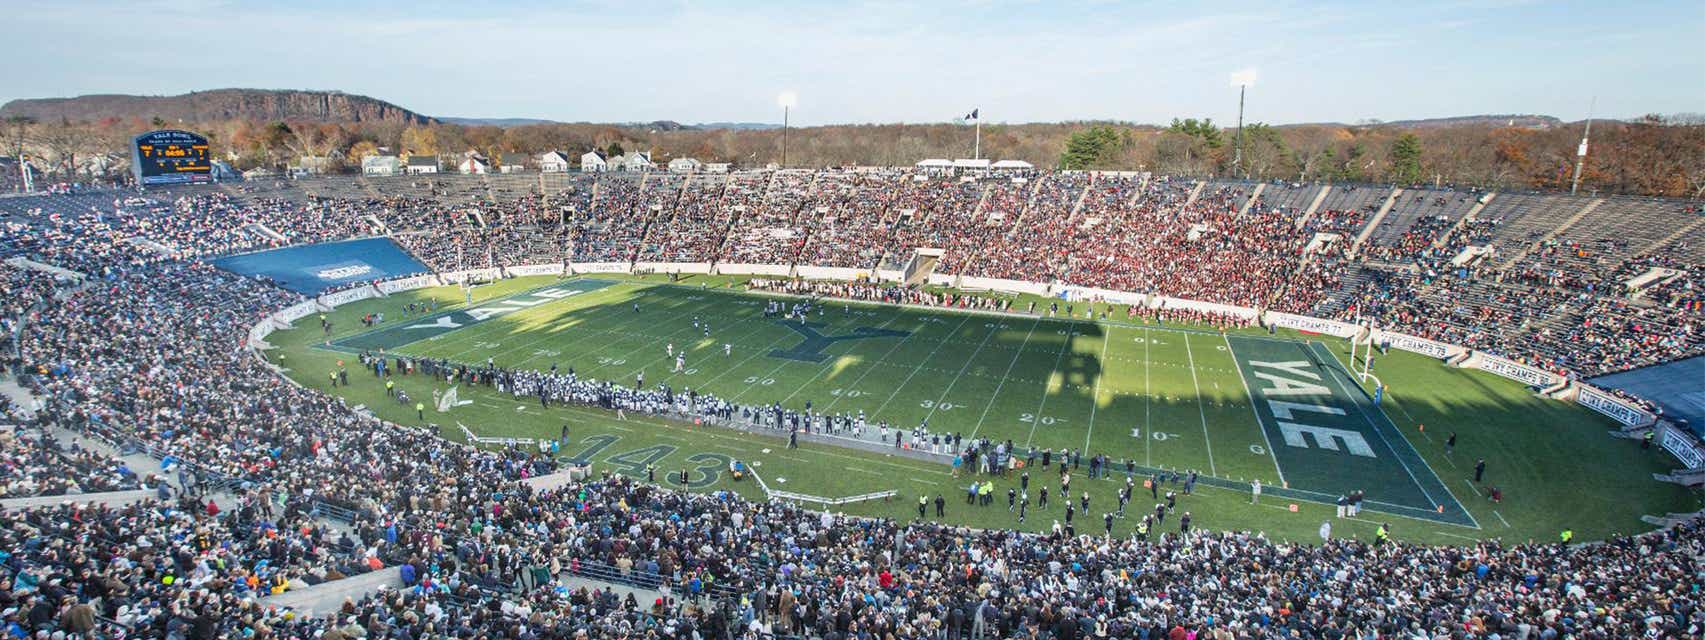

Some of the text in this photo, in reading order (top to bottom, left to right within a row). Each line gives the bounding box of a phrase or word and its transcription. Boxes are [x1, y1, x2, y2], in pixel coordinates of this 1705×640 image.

[402, 288, 584, 329] YALE
[767, 319, 912, 363] Y
[920, 399, 953, 411] 30
[1019, 413, 1055, 425] 20
[1249, 360, 1377, 458] YALE
[1129, 426, 1167, 441] 10
[555, 434, 735, 489] 143
